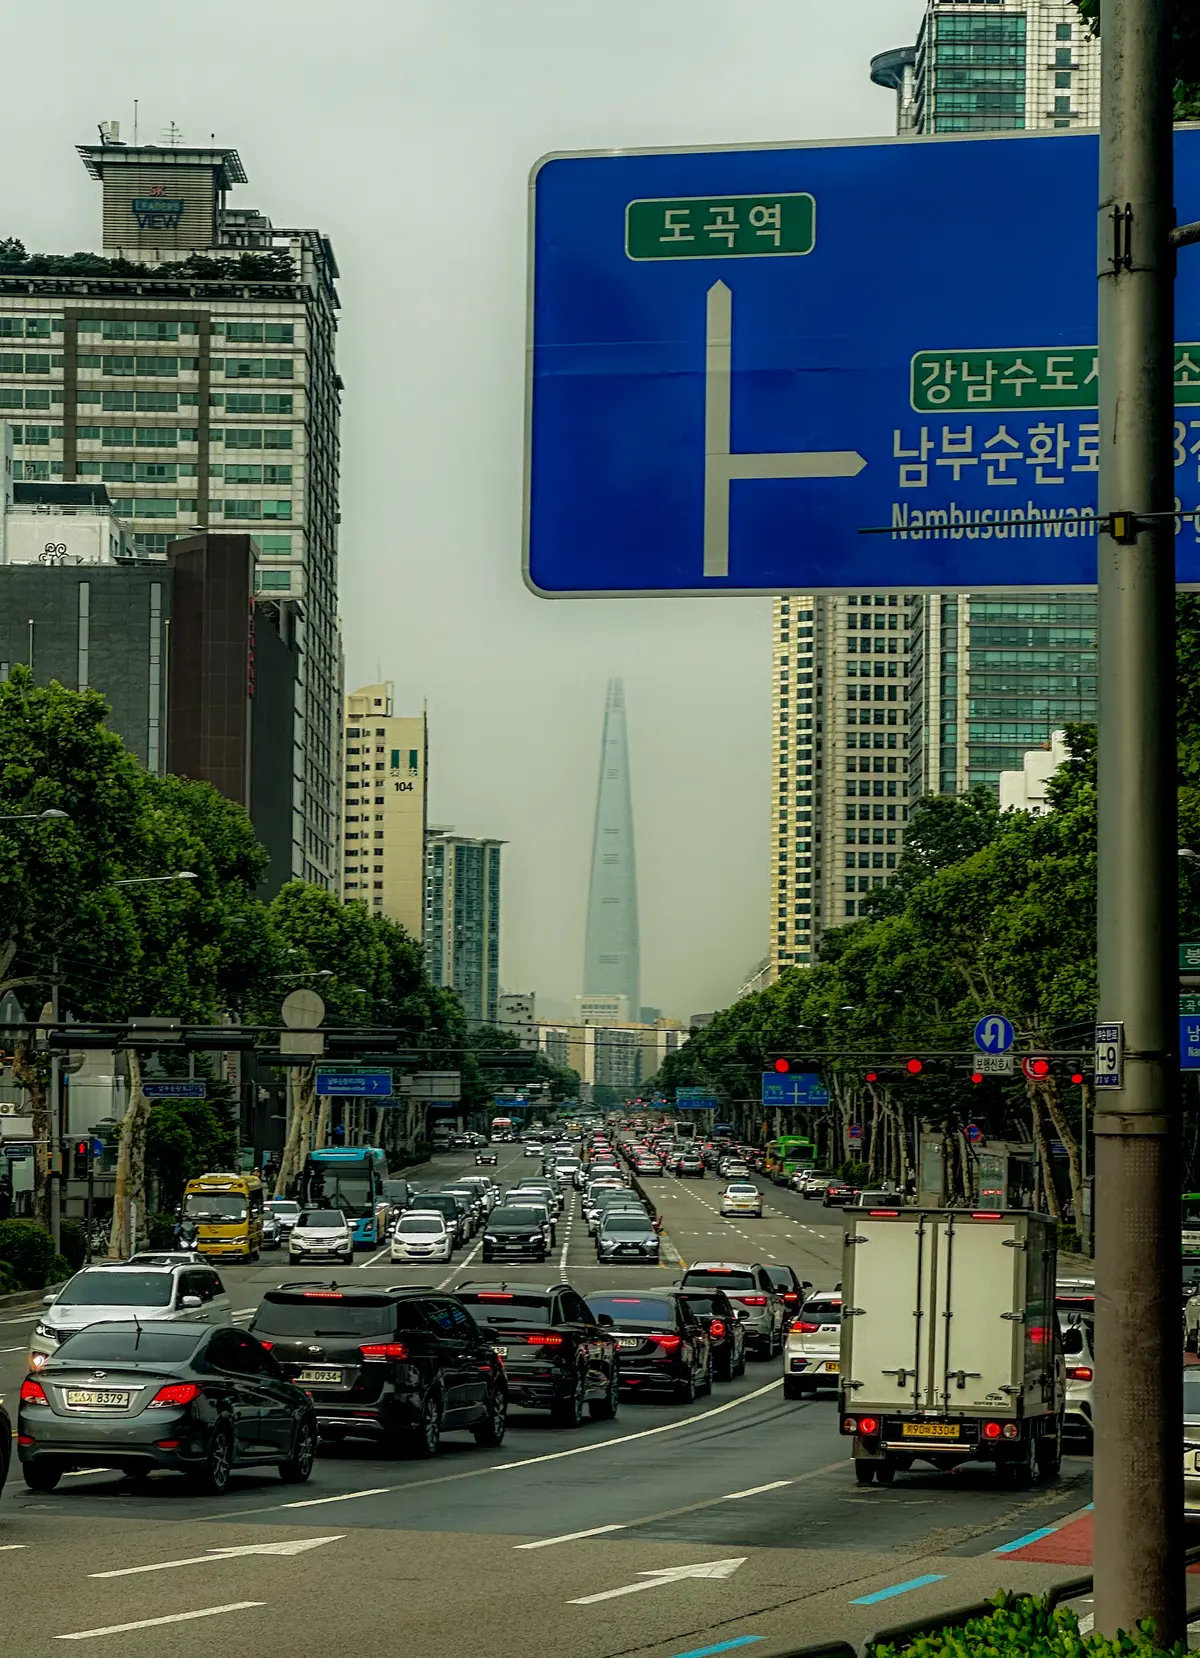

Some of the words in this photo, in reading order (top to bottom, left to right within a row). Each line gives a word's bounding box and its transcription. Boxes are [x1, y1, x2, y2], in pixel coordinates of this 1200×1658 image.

[659, 203, 781, 248] 도곡역
[394, 781, 414, 792] 104
[96, 1392, 123, 1404] 8379
